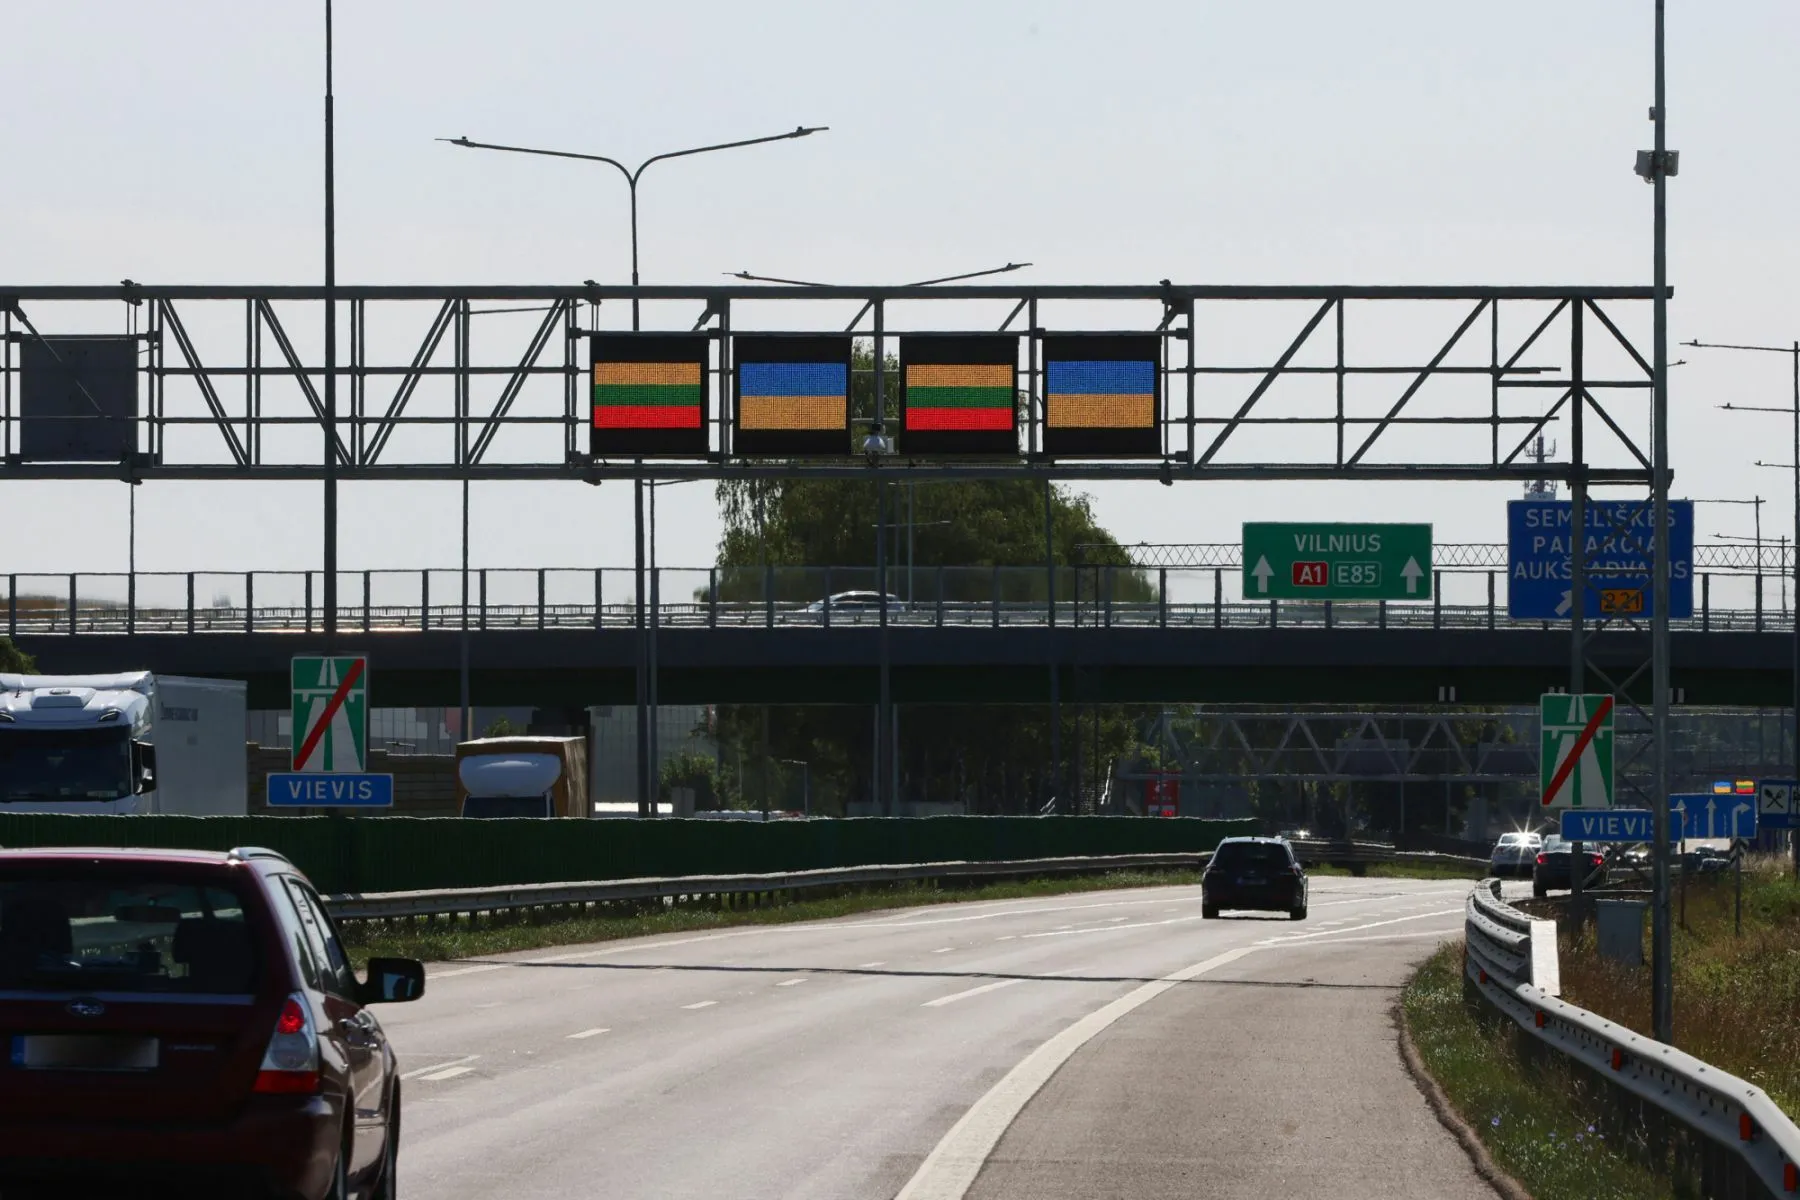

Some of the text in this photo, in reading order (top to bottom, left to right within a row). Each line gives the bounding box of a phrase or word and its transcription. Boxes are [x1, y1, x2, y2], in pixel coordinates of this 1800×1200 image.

[1294, 534, 1381, 552] VILNIUS
[1533, 529, 1656, 554] PAARČIA
[1299, 565, 1376, 584] A1 E85
[1514, 555, 1688, 580] AUKŠADVAIS
[1604, 592, 1639, 610] 221
[288, 780, 372, 800] VIEVIS
